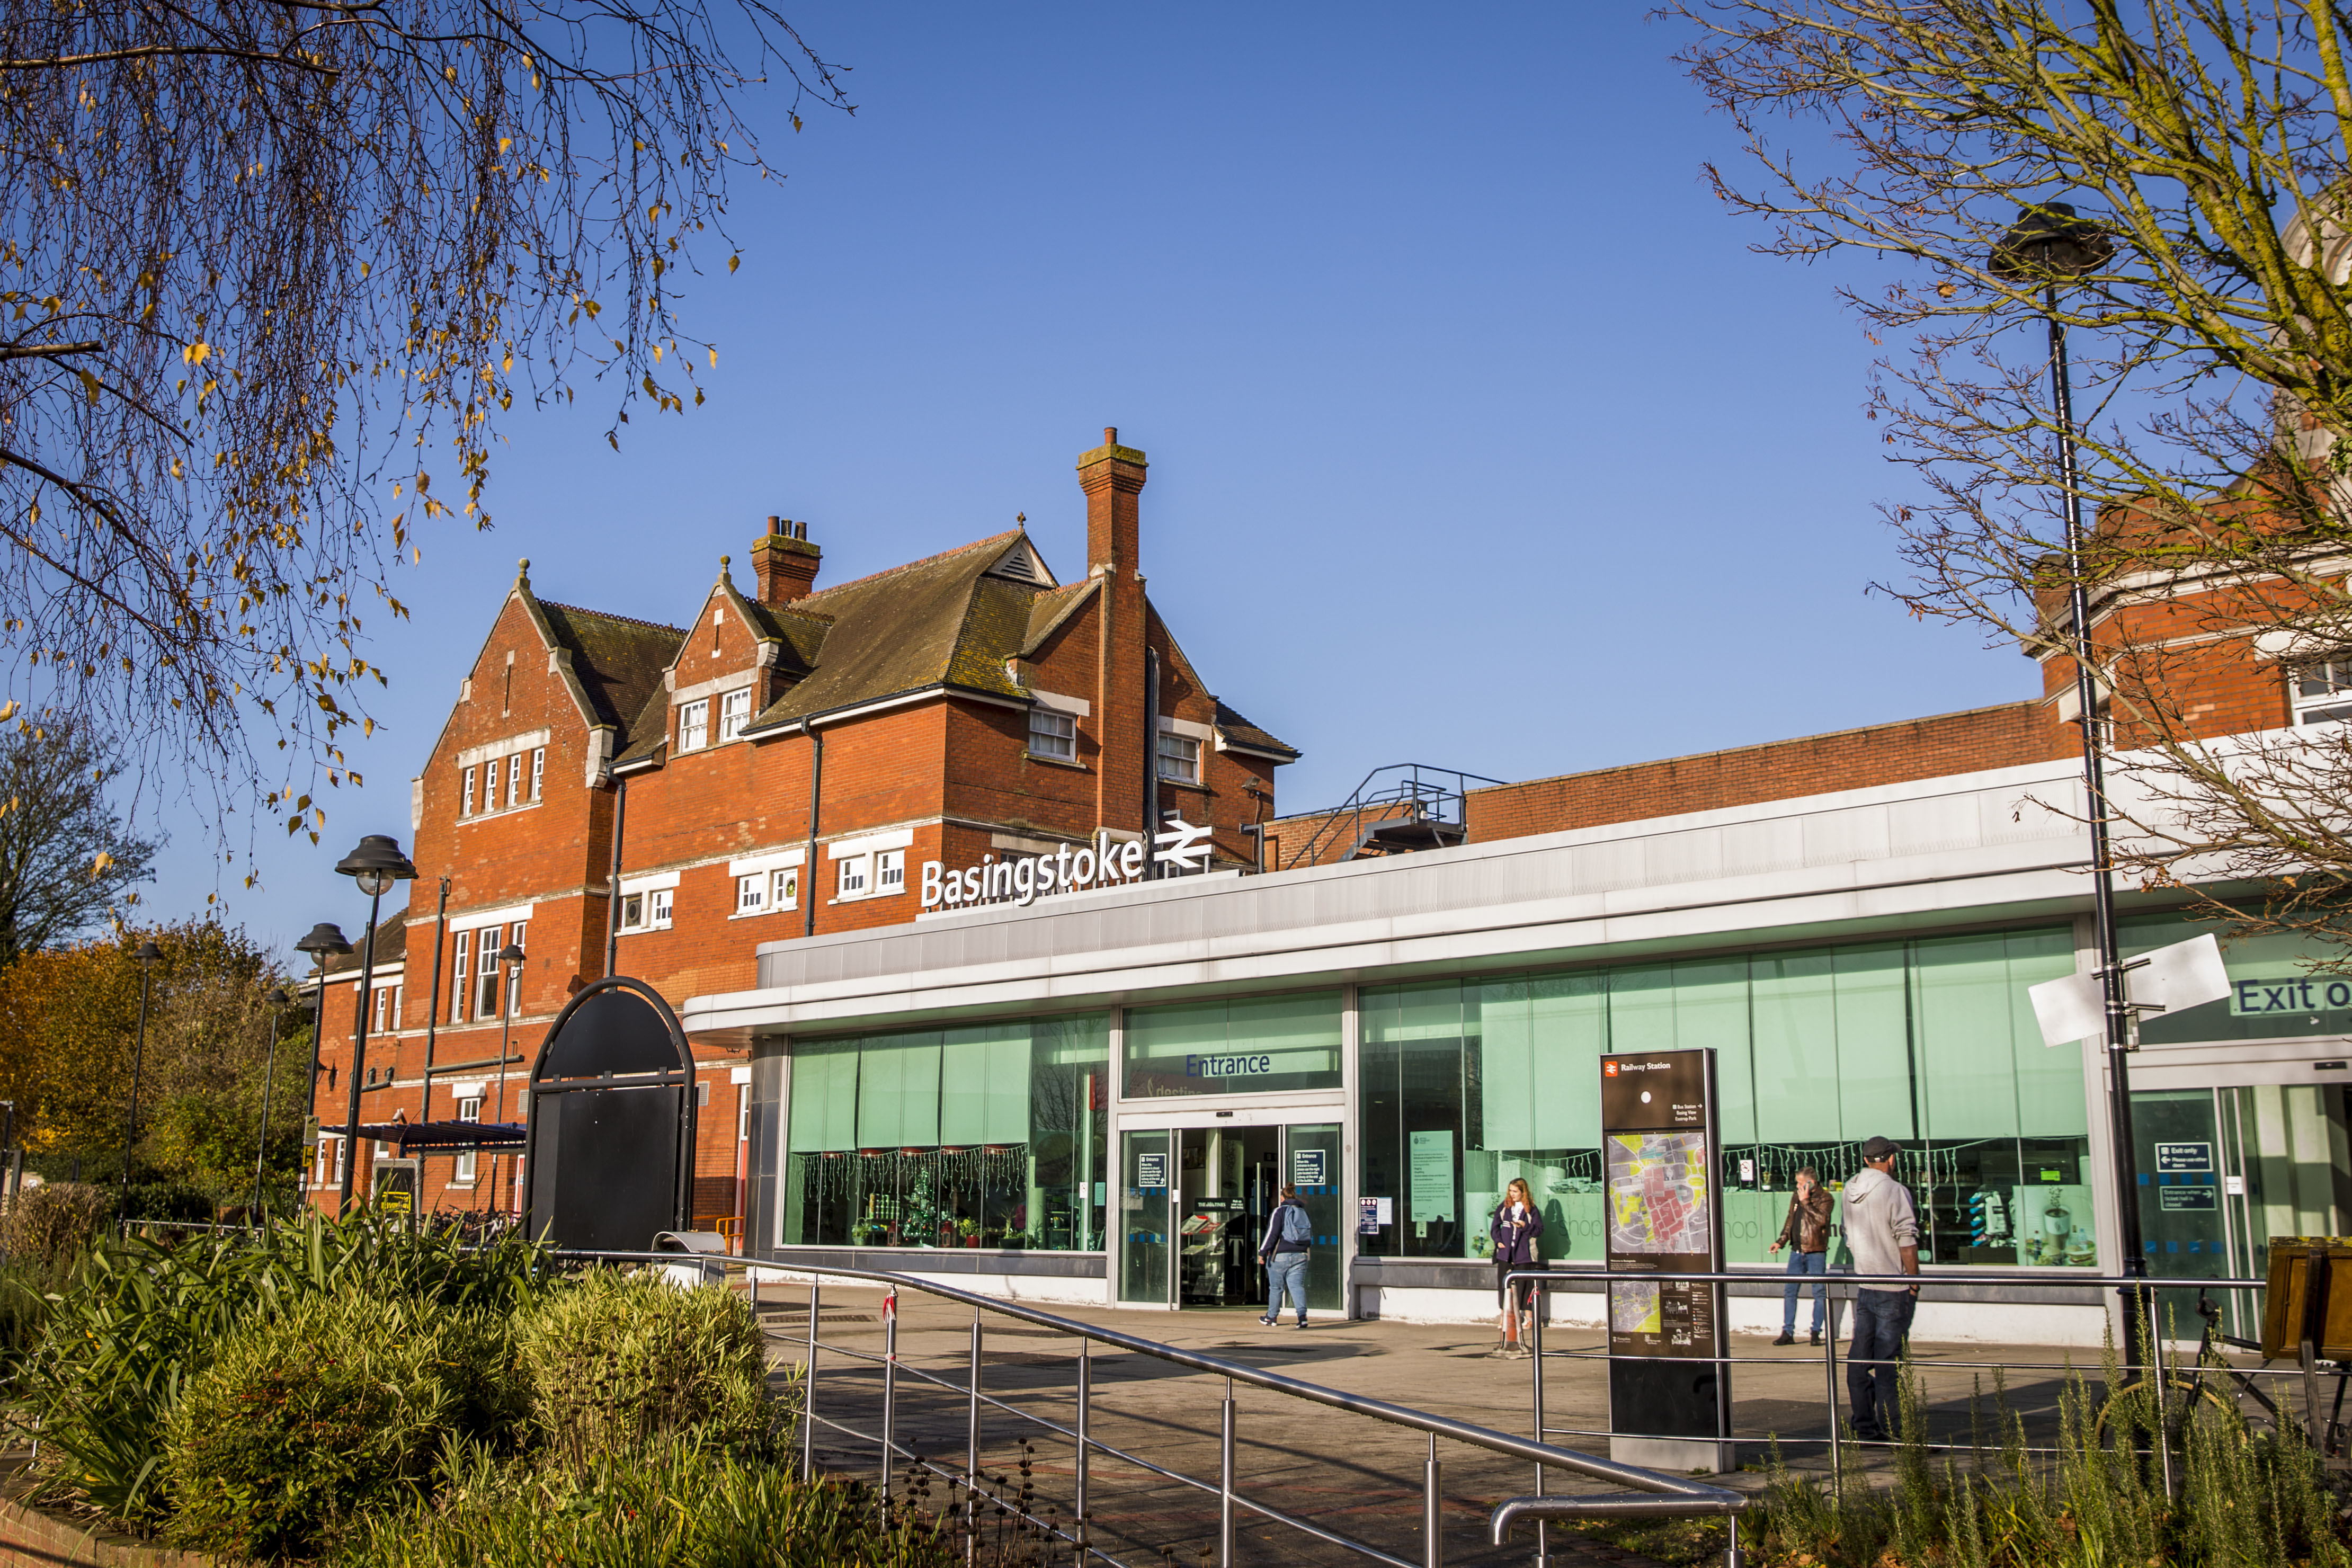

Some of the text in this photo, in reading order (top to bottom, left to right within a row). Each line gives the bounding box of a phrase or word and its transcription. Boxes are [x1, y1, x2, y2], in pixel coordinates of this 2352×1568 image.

[921, 832, 1145, 907] Basingstoke
[2238, 978, 2315, 1012] Exit
[1186, 1054, 1270, 1077] Entrance
[1646, 1062, 1671, 1070] Station
[1559, 1214, 1602, 1242] shop
[1229, 1239, 1244, 1266] T
